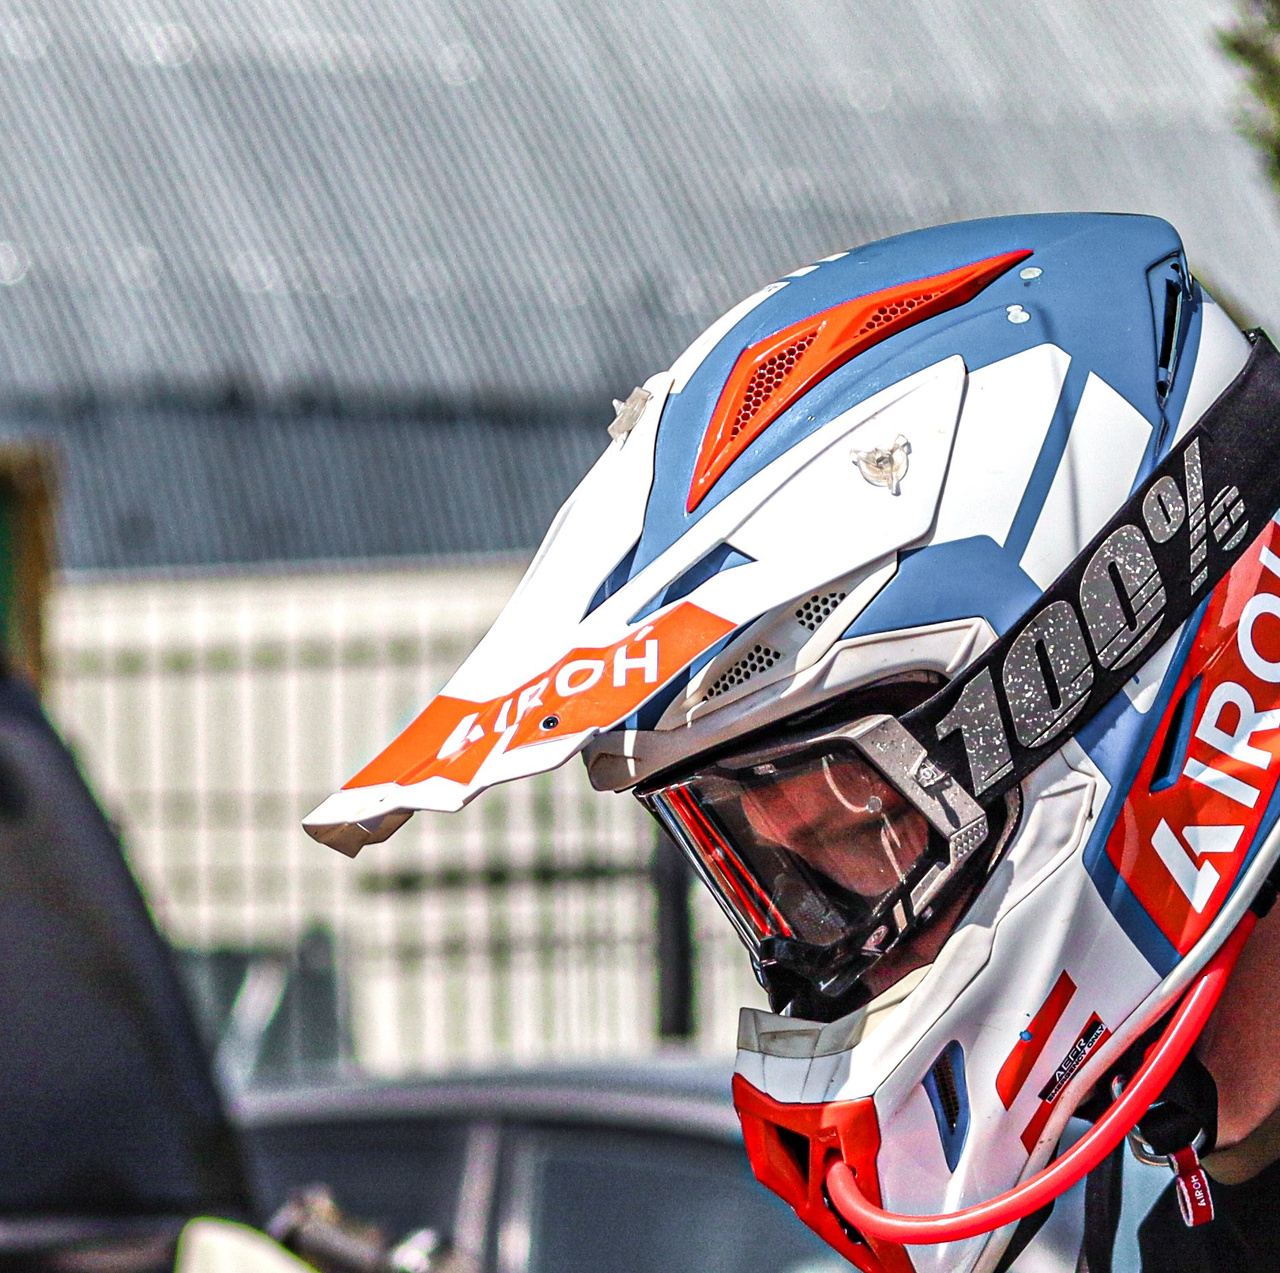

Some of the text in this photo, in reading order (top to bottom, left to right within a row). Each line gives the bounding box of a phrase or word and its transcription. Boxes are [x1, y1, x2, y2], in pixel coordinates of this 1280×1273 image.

[936, 436, 1250, 798] 100%
[1046, 1023, 1105, 1103] EMERGENCY ONLY
[1190, 1174, 1207, 1207] AIROH
